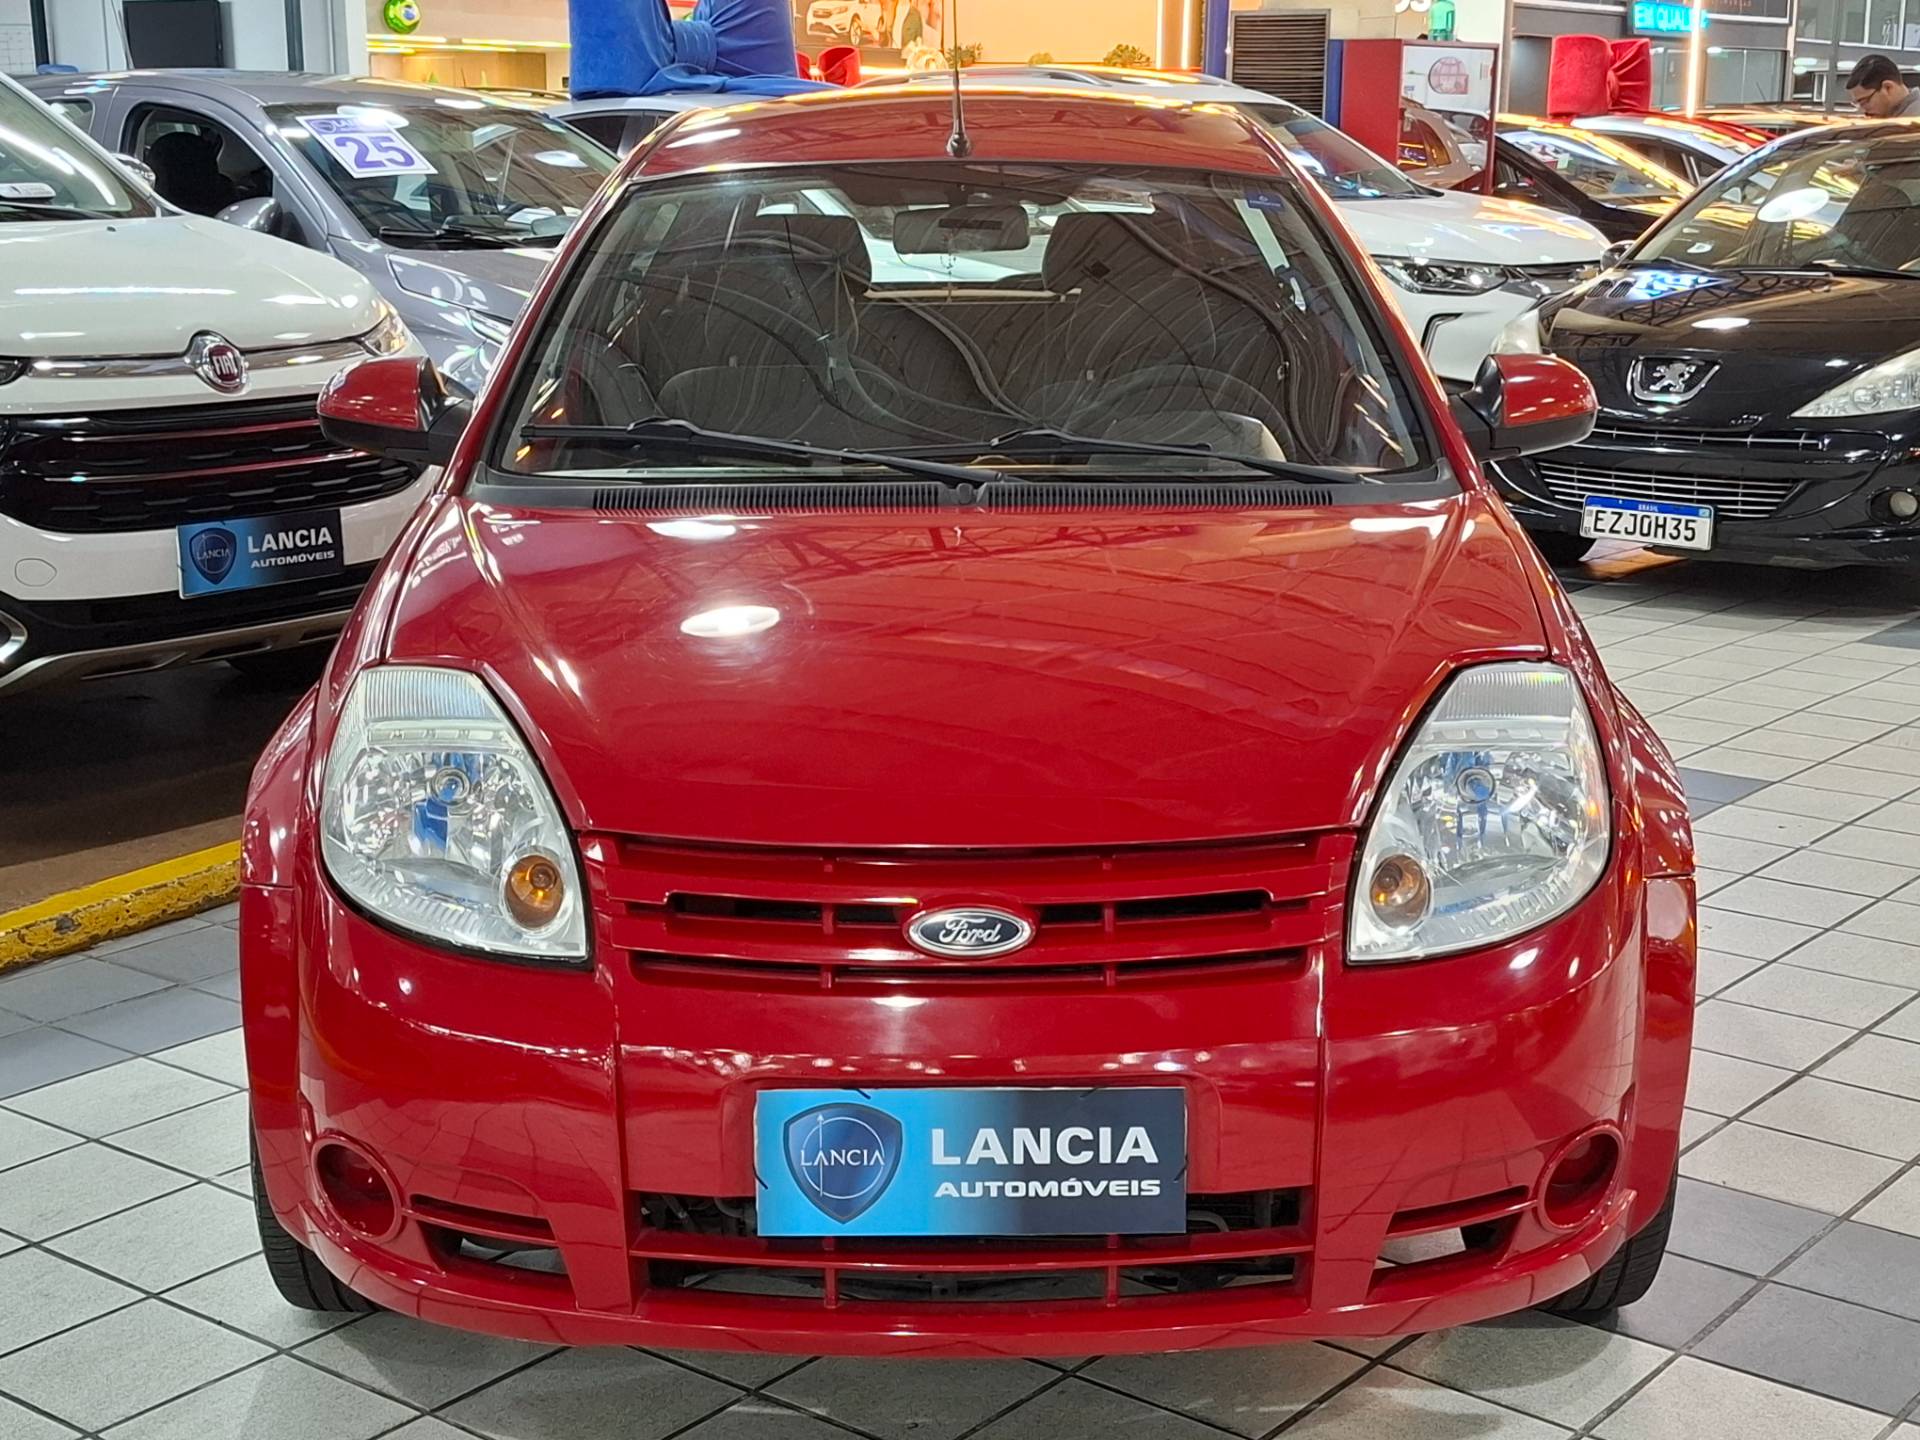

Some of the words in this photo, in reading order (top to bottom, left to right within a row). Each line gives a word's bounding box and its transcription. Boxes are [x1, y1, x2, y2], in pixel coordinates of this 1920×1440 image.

[334, 136, 415, 169] 25
[212, 351, 238, 376] FIAT
[247, 526, 334, 554] LANCIA
[196, 548, 231, 561] LANCIA
[938, 917, 1002, 943] Ford
[800, 1148, 885, 1167] LANCIA
[931, 1126, 1159, 1166] LANCIA
[934, 1178, 1161, 1198] AUTOMÓVEIS
